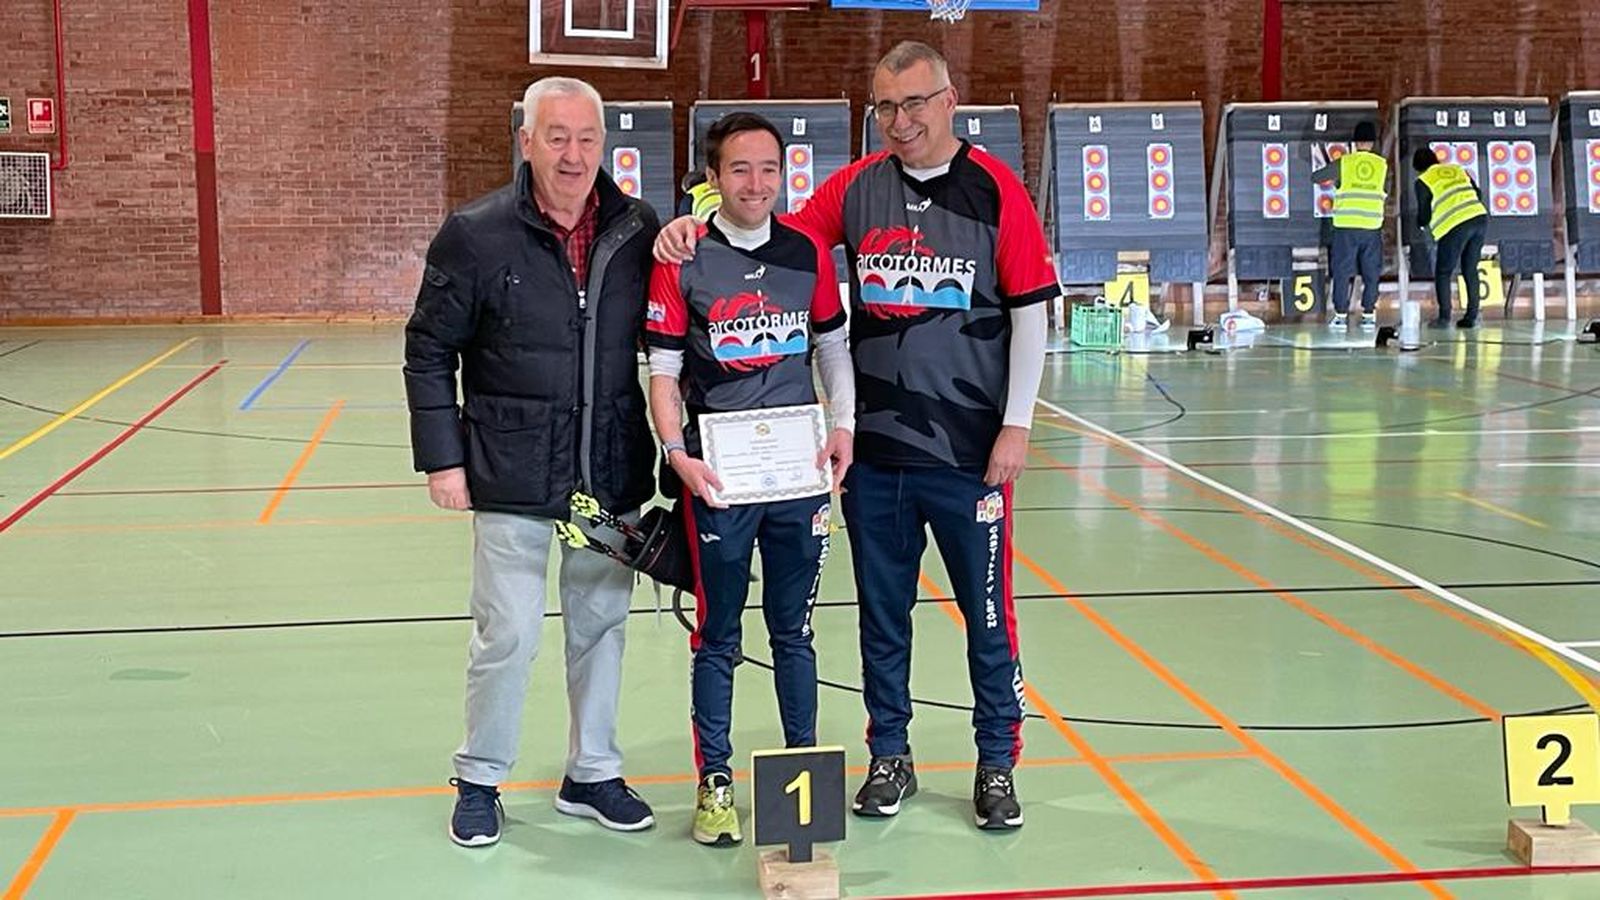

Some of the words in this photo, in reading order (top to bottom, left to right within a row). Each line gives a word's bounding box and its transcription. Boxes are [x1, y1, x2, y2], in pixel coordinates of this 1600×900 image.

[750, 52, 762, 82] 1
[1119, 280, 1136, 307] 4
[1293, 275, 1315, 312] 5
[1536, 733, 1574, 787] 2
[785, 770, 811, 826] 1
